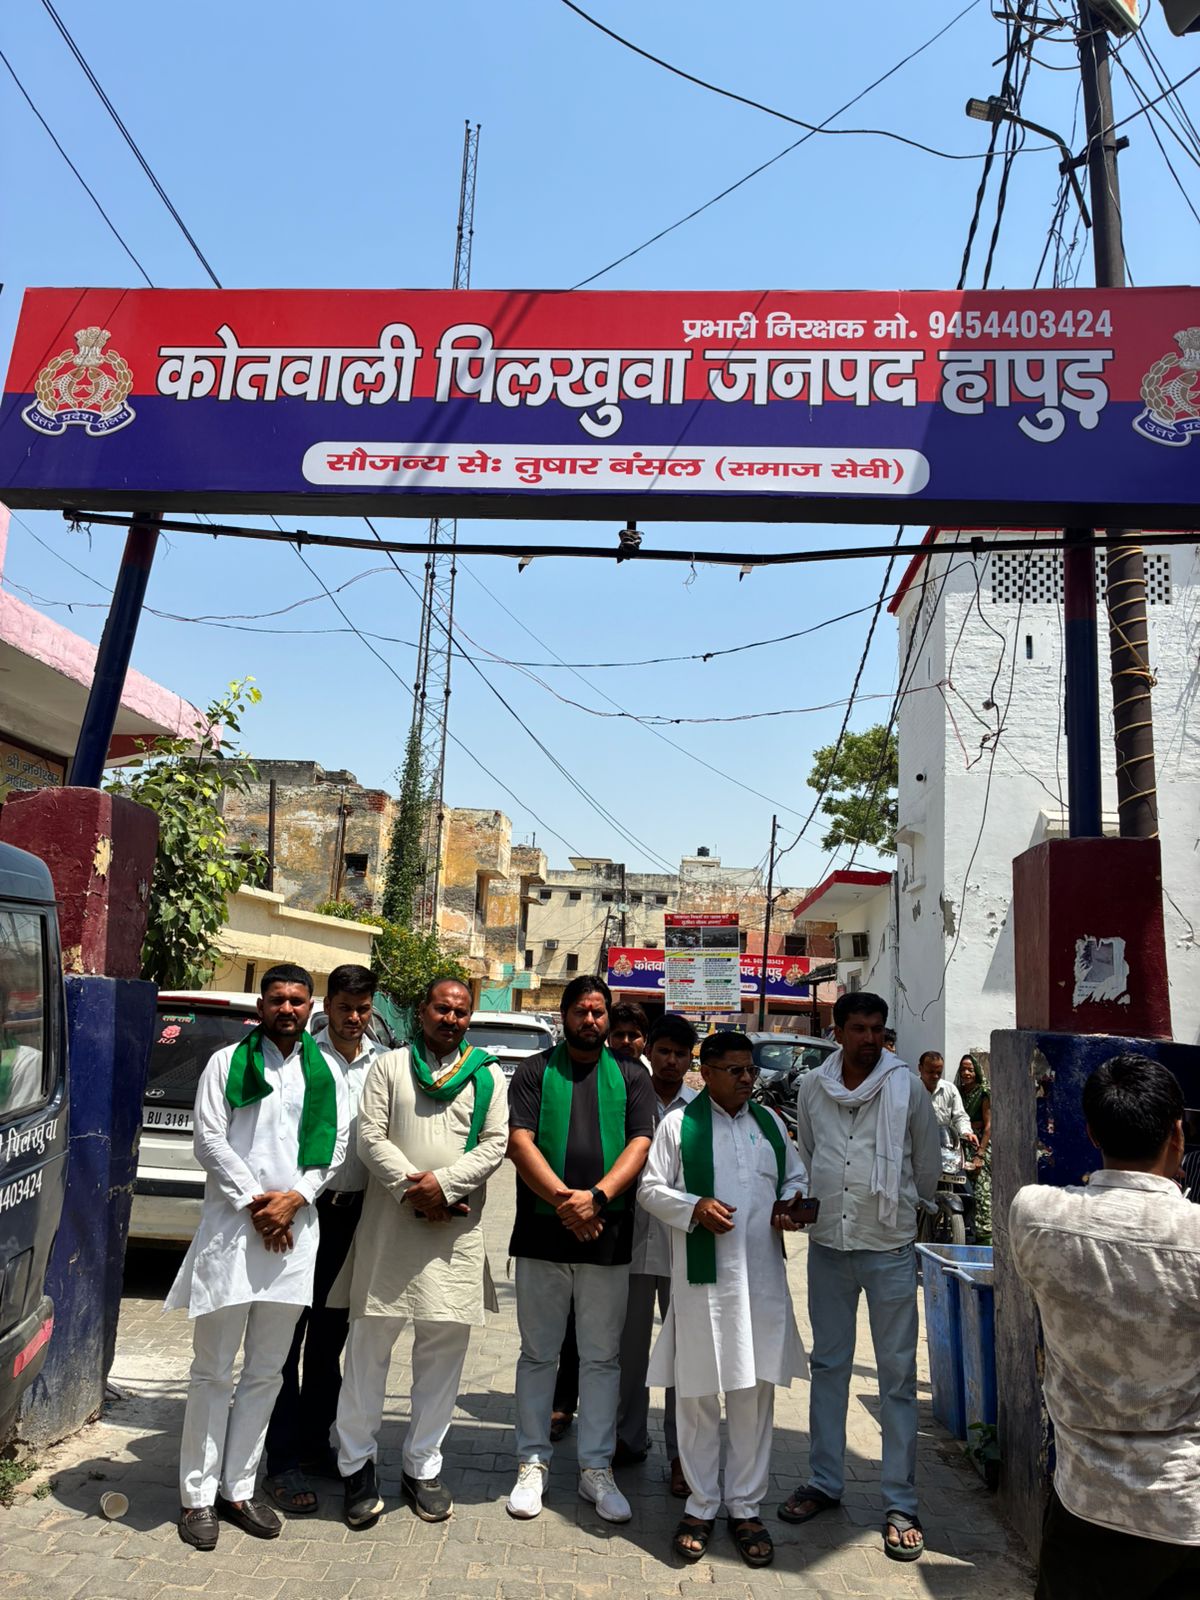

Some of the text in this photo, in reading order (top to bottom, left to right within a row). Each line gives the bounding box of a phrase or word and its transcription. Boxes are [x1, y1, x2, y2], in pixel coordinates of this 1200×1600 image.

[682, 309, 1114, 341] प्रभारी निरक्षक मो. 9454403424
[157, 322, 1115, 443] कोतवाली पिलखुवा जनपद हापुड़
[31, 411, 128, 431] उत्तर प्रदेश पुलिस
[1144, 421, 1177, 441] उत्तर
[326, 447, 447, 474] सौजन्य
[513, 455, 603, 482] तुषार
[609, 451, 706, 476] बंसल
[714, 456, 822, 481] (समाज
[831, 457, 905, 483] सेवी)
[147, 1111, 190, 1128] BU 3181
[6, 1119, 59, 1163] पिलखुवा
